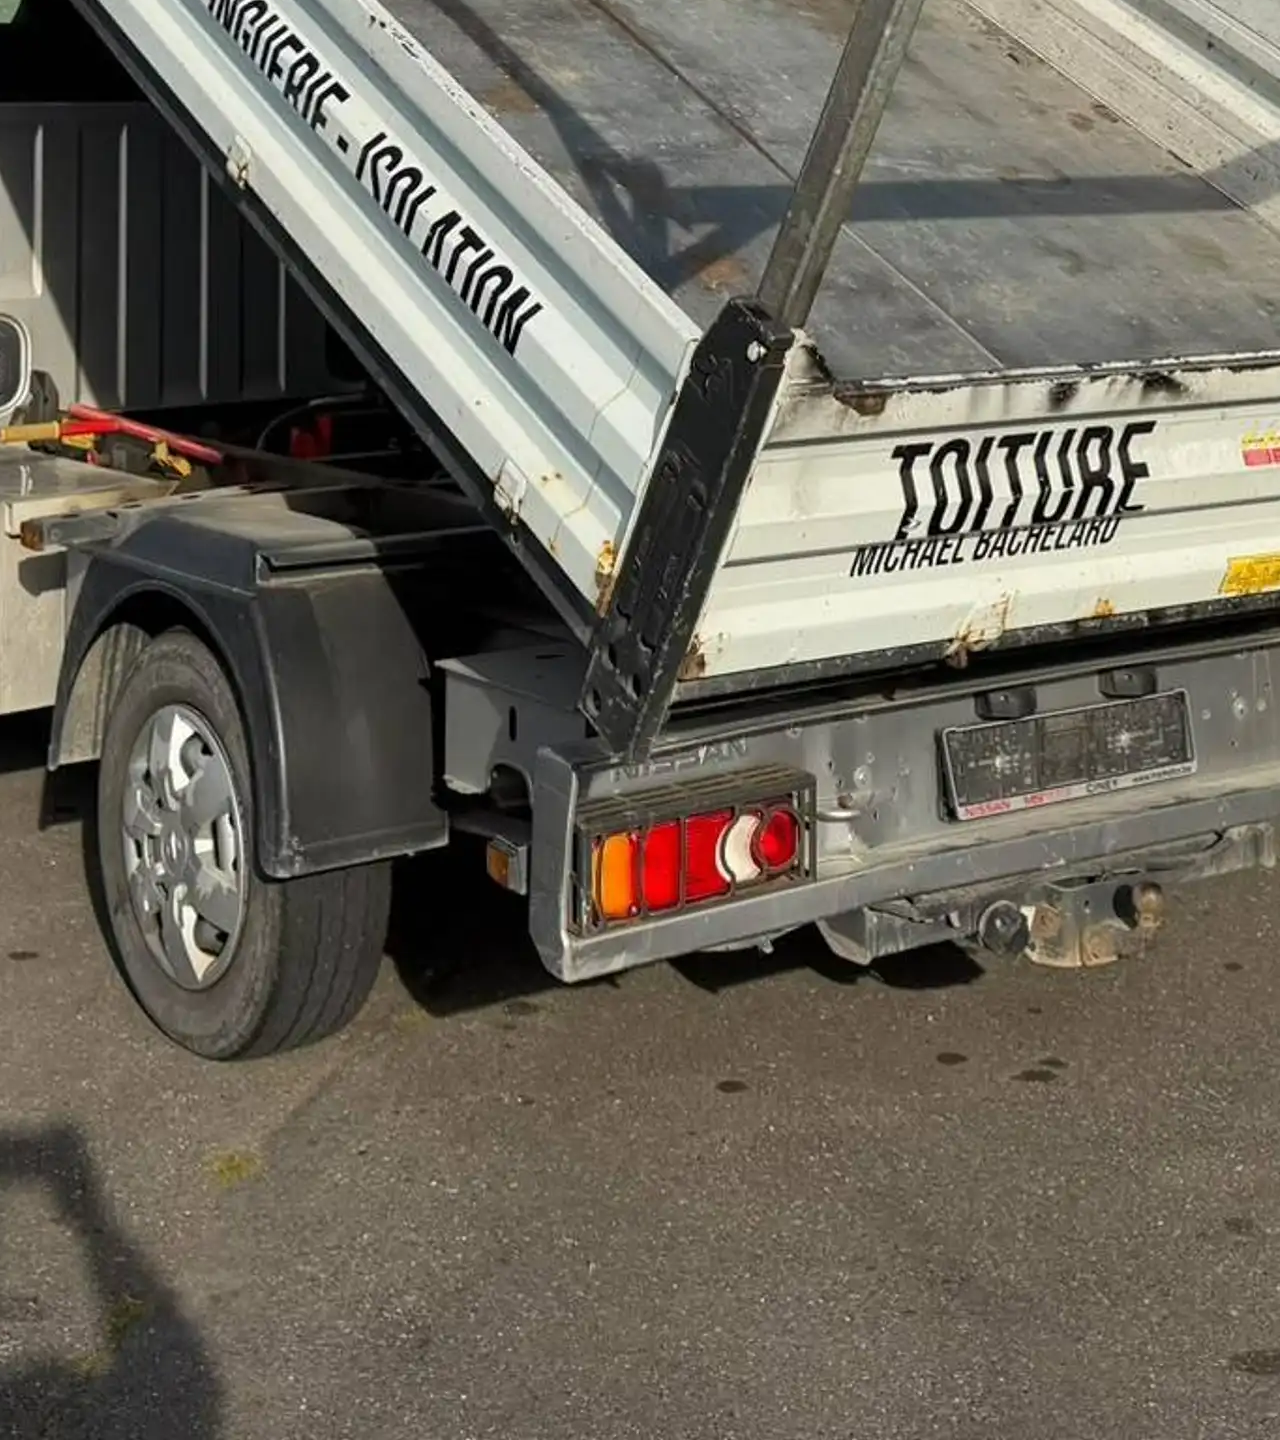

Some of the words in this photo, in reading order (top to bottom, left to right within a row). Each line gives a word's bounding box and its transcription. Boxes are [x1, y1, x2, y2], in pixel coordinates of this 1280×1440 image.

[891, 420, 1157, 541] TOITURE
[849, 535, 966, 578] MICHAEL
[971, 517, 1122, 561] BACHELARD
